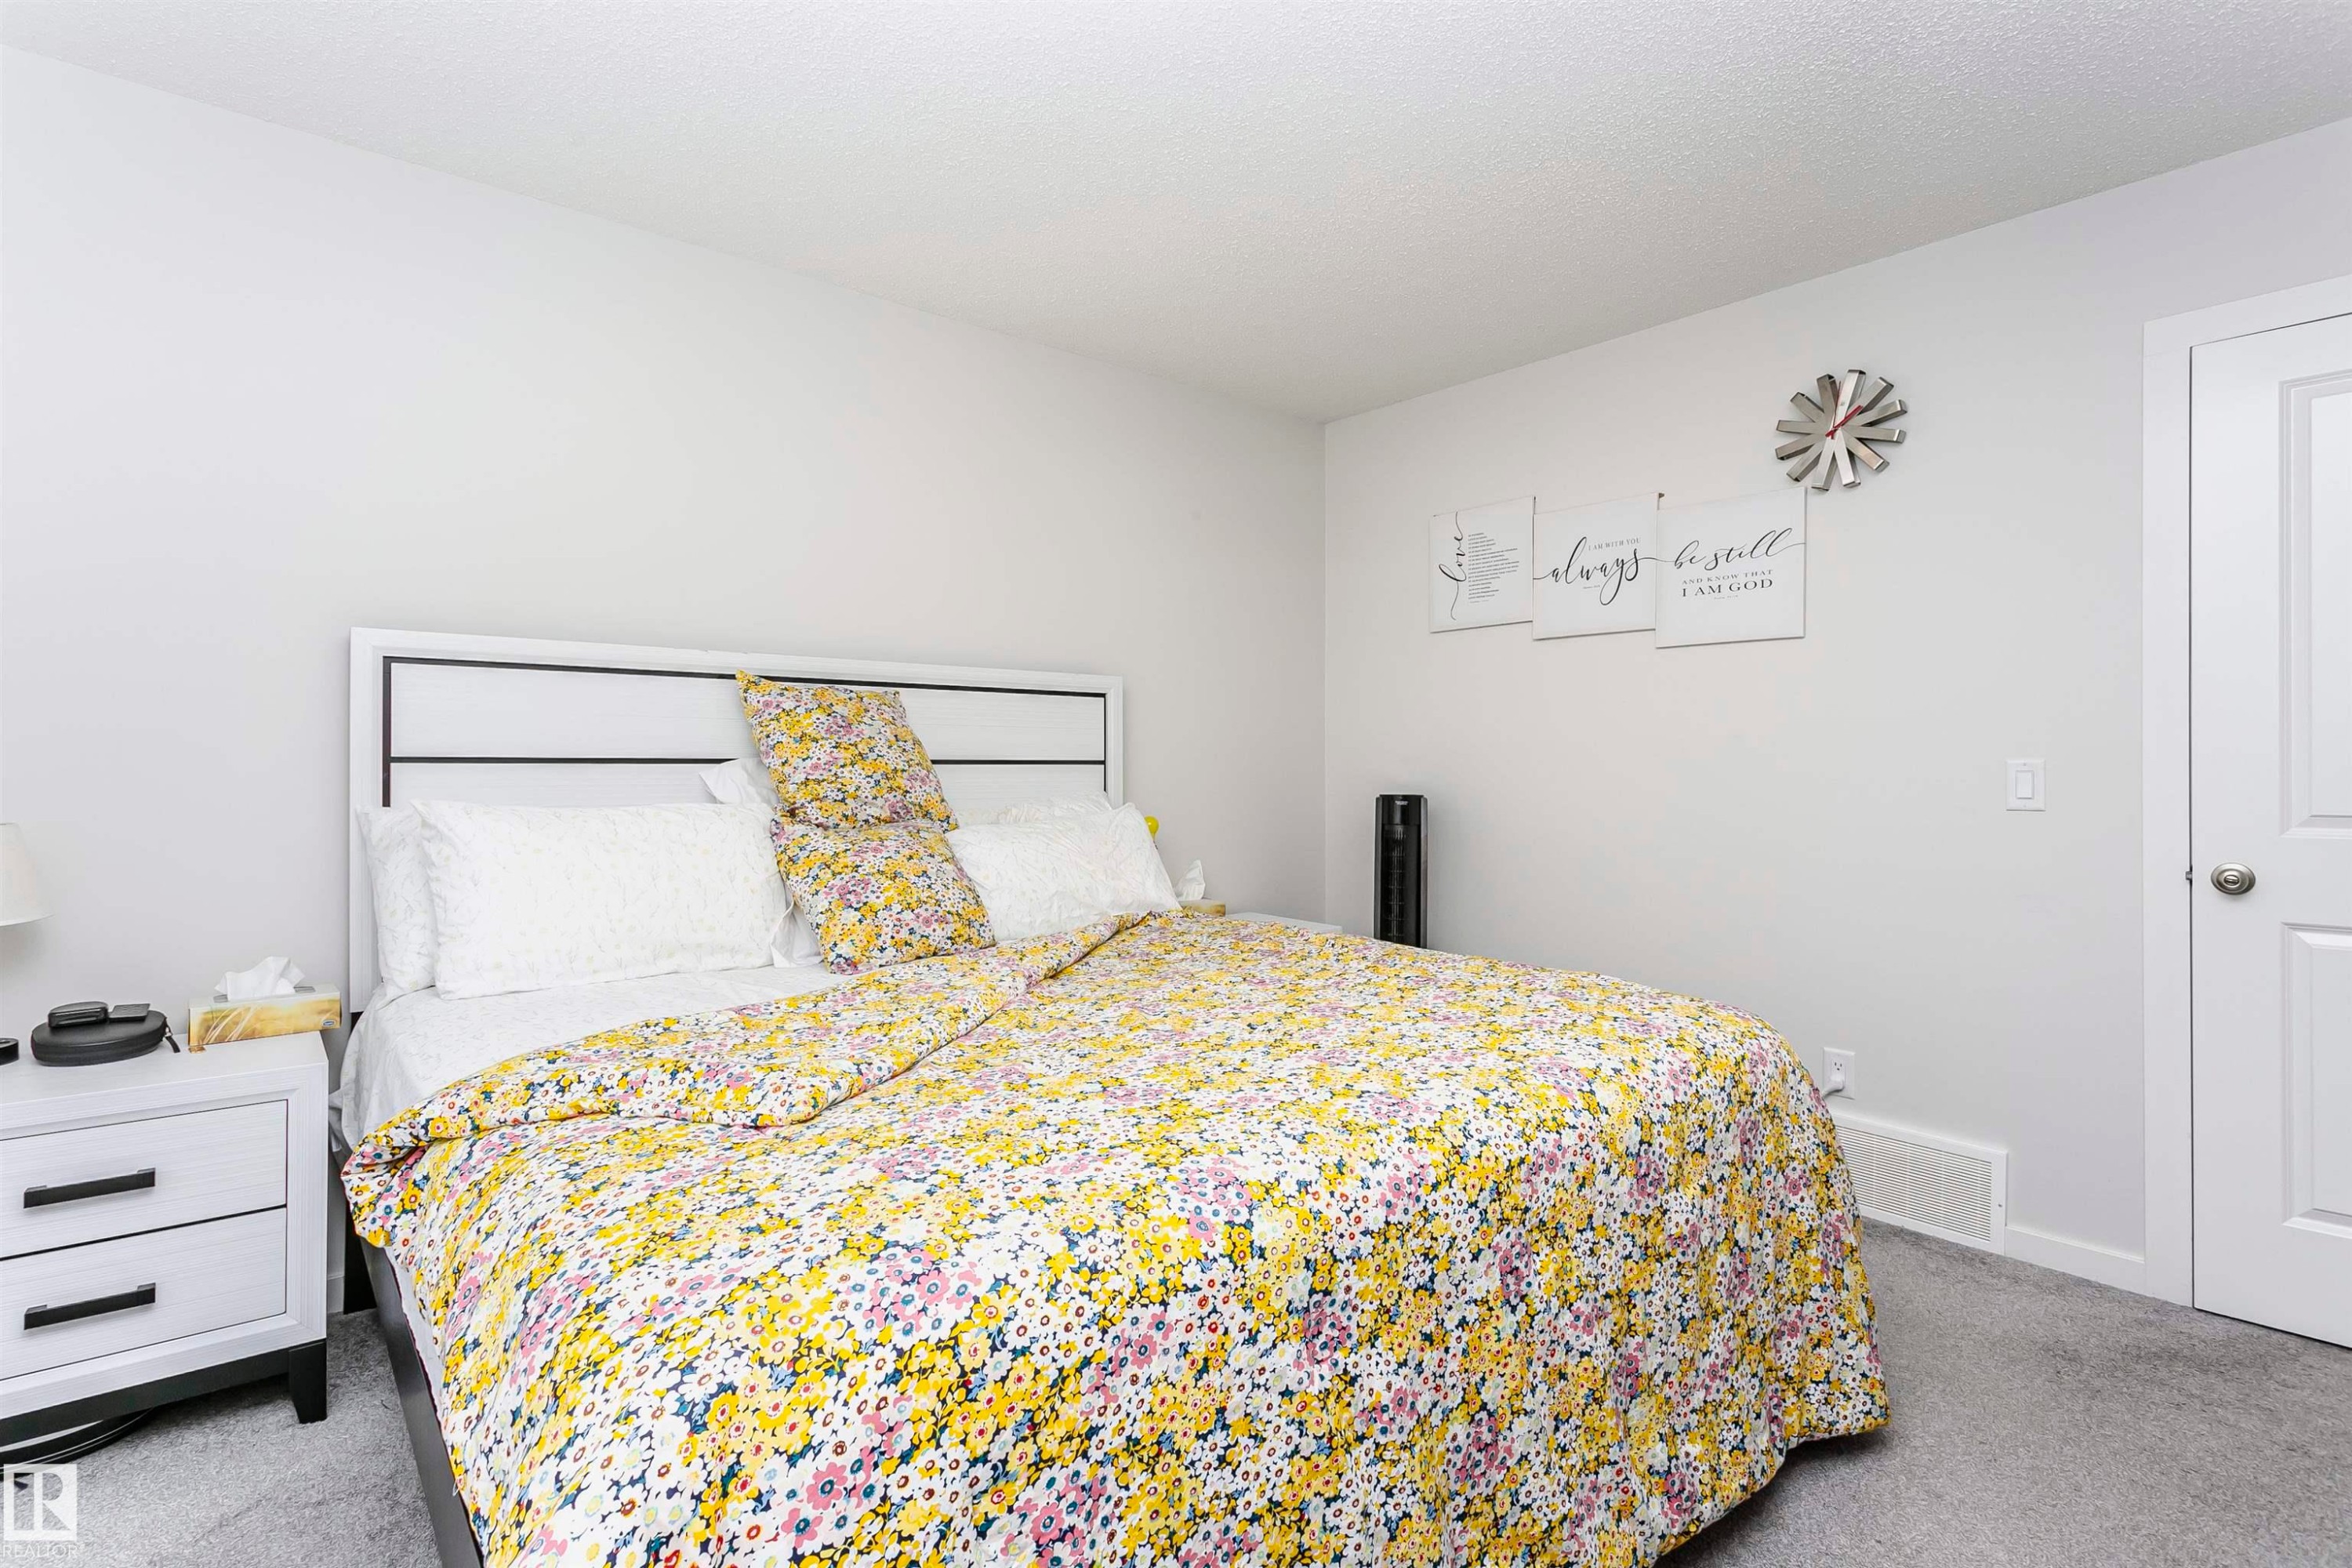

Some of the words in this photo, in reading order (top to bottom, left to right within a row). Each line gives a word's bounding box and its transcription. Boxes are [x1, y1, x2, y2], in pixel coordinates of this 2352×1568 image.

[1605, 539, 1624, 549] WITH
[1674, 539, 1707, 569] be
[1704, 528, 1806, 571] still
[1534, 536, 1656, 606] always
[1707, 573, 1740, 583] KNOW
[1743, 569, 1773, 578] THAT
[1682, 588, 1686, 597] I
[1694, 584, 1722, 596] AM
[1729, 578, 1773, 592] GOD
